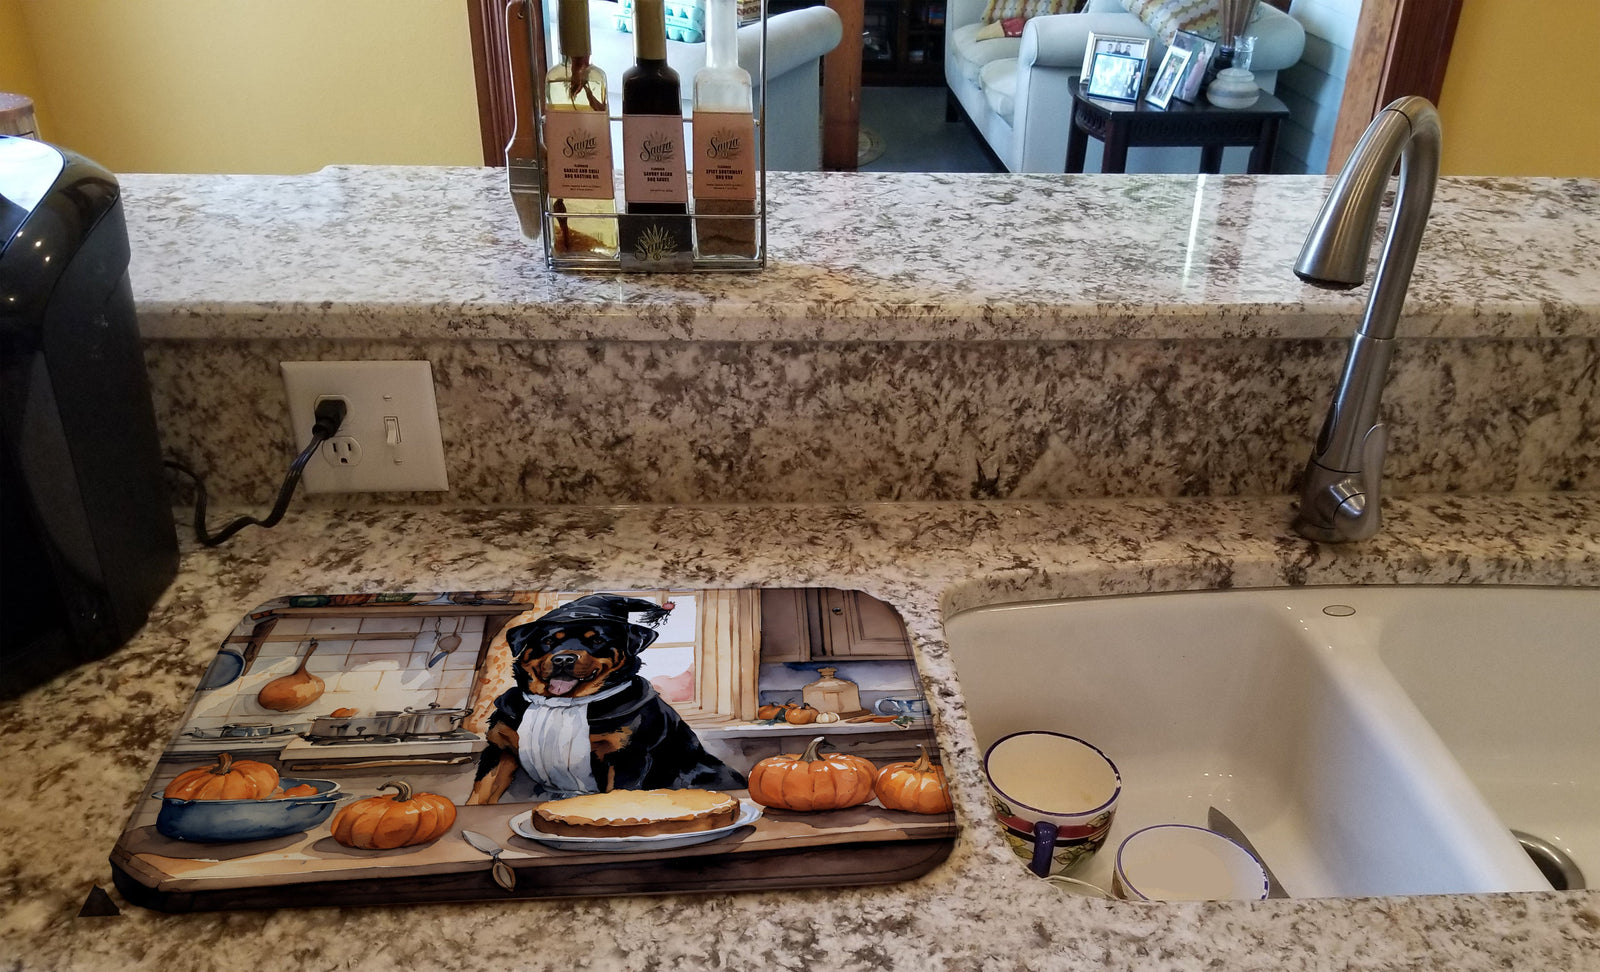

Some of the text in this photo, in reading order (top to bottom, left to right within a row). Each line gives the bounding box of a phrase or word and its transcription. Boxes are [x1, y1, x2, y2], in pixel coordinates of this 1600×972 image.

[563, 136, 597, 158] Sauza
[640, 140, 674, 161] Sauza
[706, 137, 740, 159] Sauza
